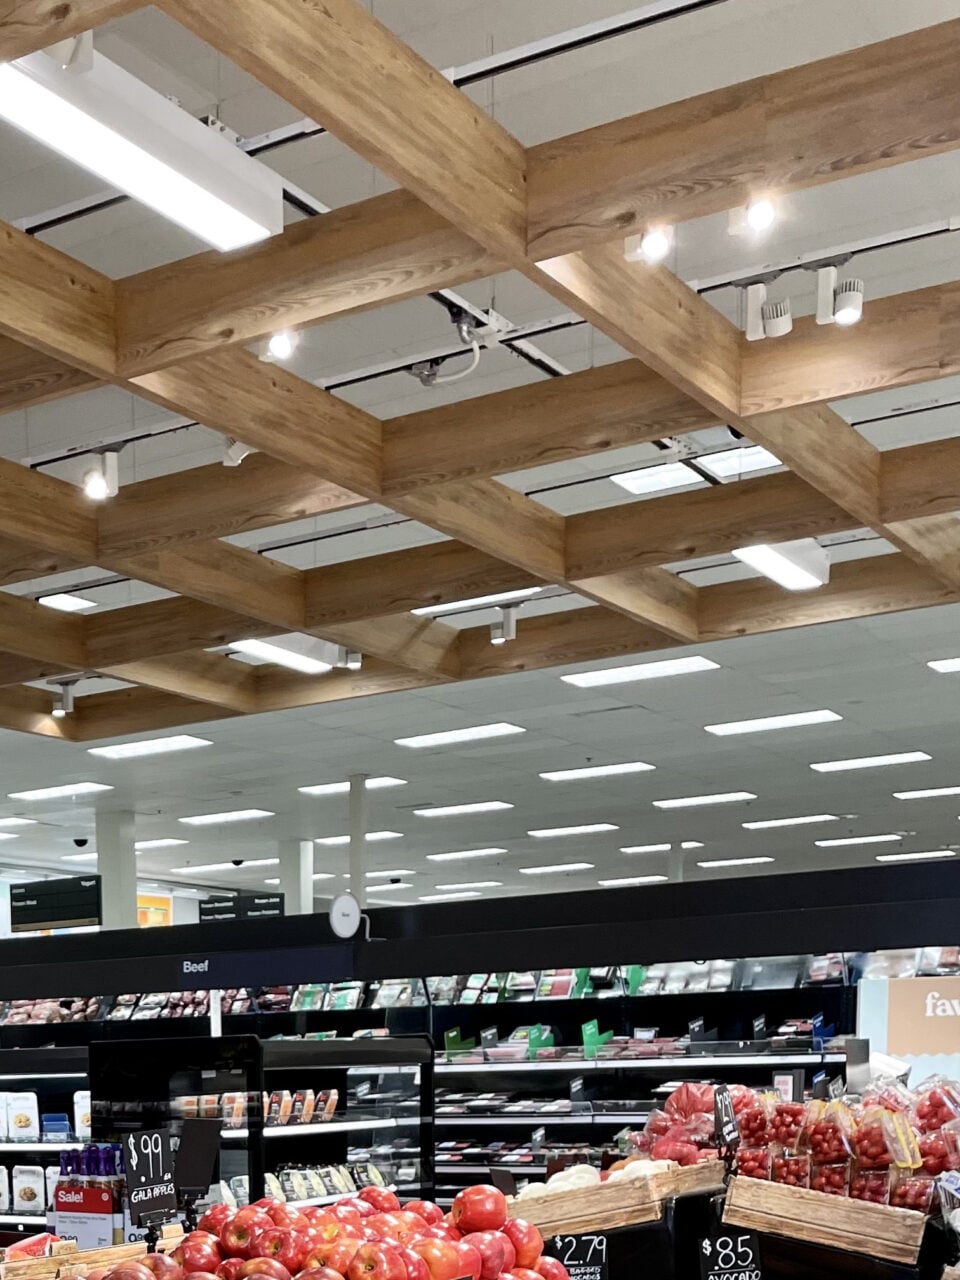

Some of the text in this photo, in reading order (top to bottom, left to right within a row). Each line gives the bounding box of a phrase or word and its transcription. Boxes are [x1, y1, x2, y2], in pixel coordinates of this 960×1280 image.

[183, 960, 209, 973] Beef
[58, 1190, 84, 1203] Sale!
[131, 1183, 175, 1203] GALA APPLES
[555, 1235, 606, 1264] $2.79
